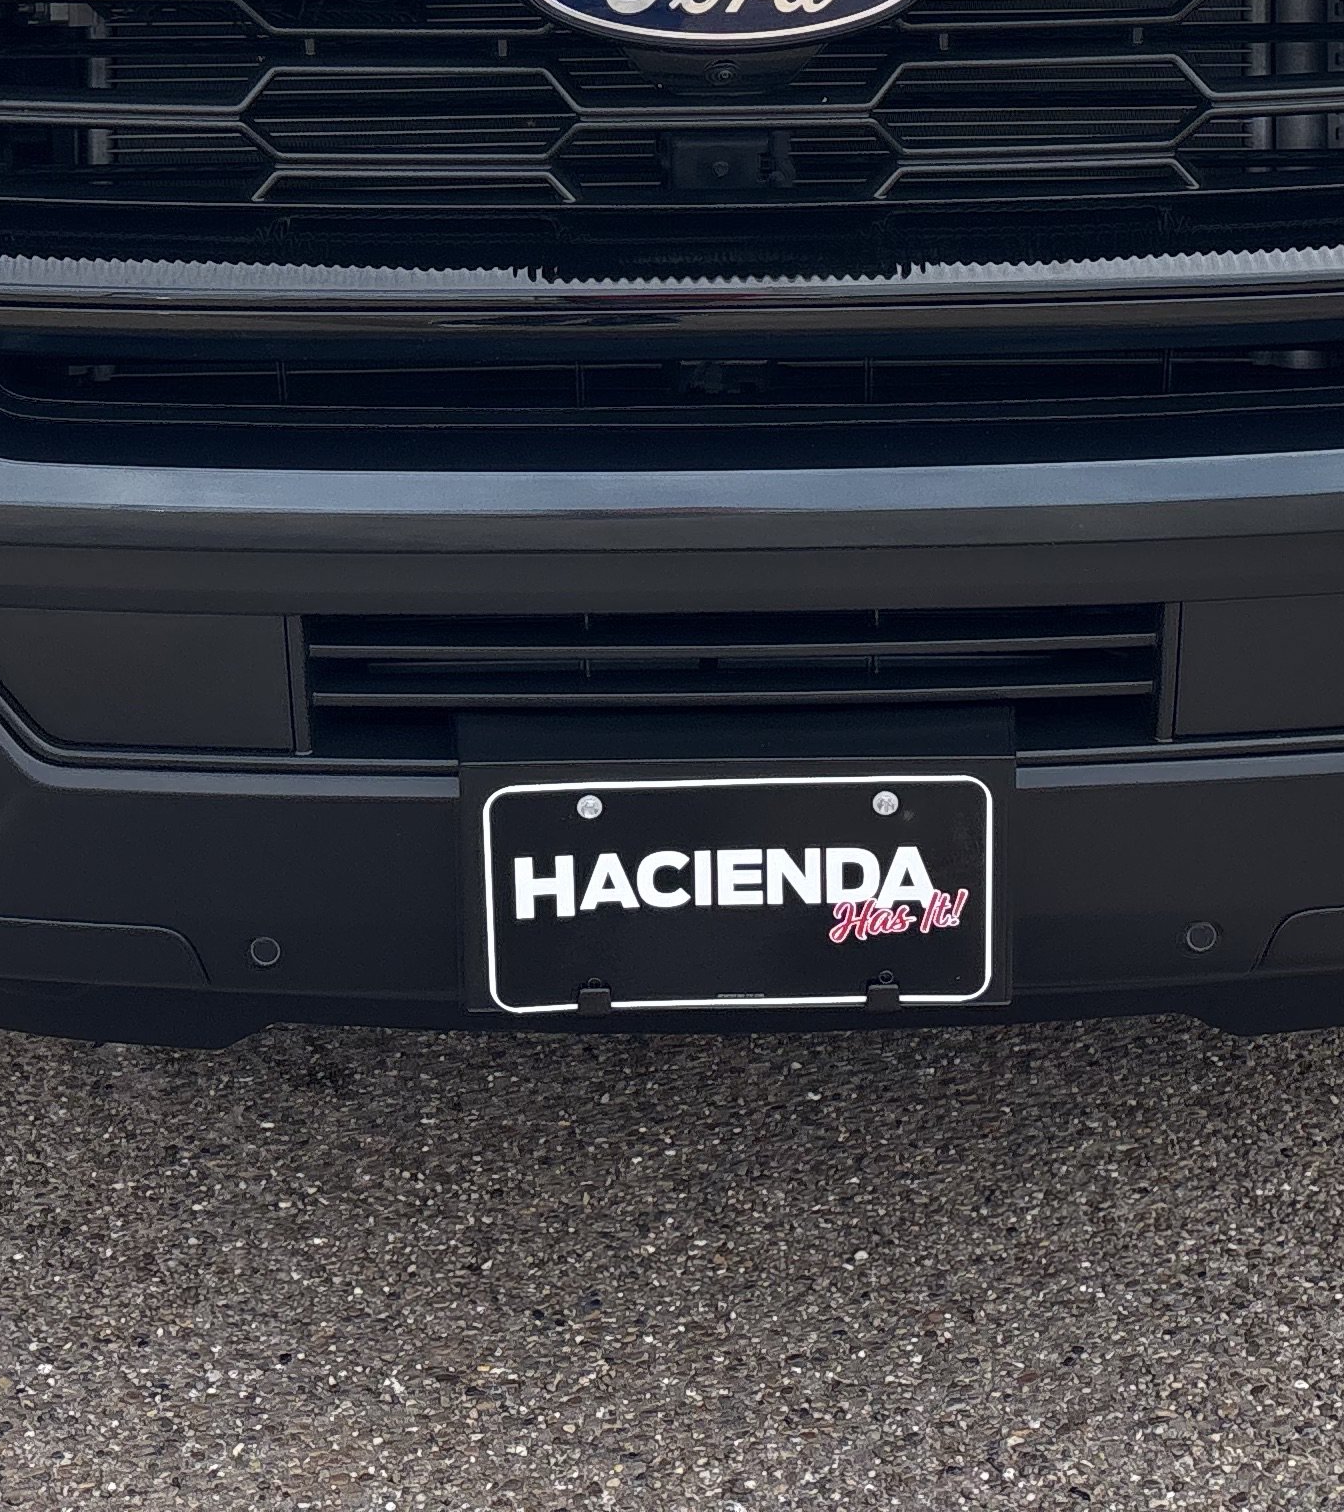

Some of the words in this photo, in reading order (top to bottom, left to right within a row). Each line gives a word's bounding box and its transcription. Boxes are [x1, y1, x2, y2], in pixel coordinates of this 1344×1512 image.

[513, 846, 936, 920] HACIENDA
[829, 897, 918, 943] Has
[919, 888, 969, 934] It!
